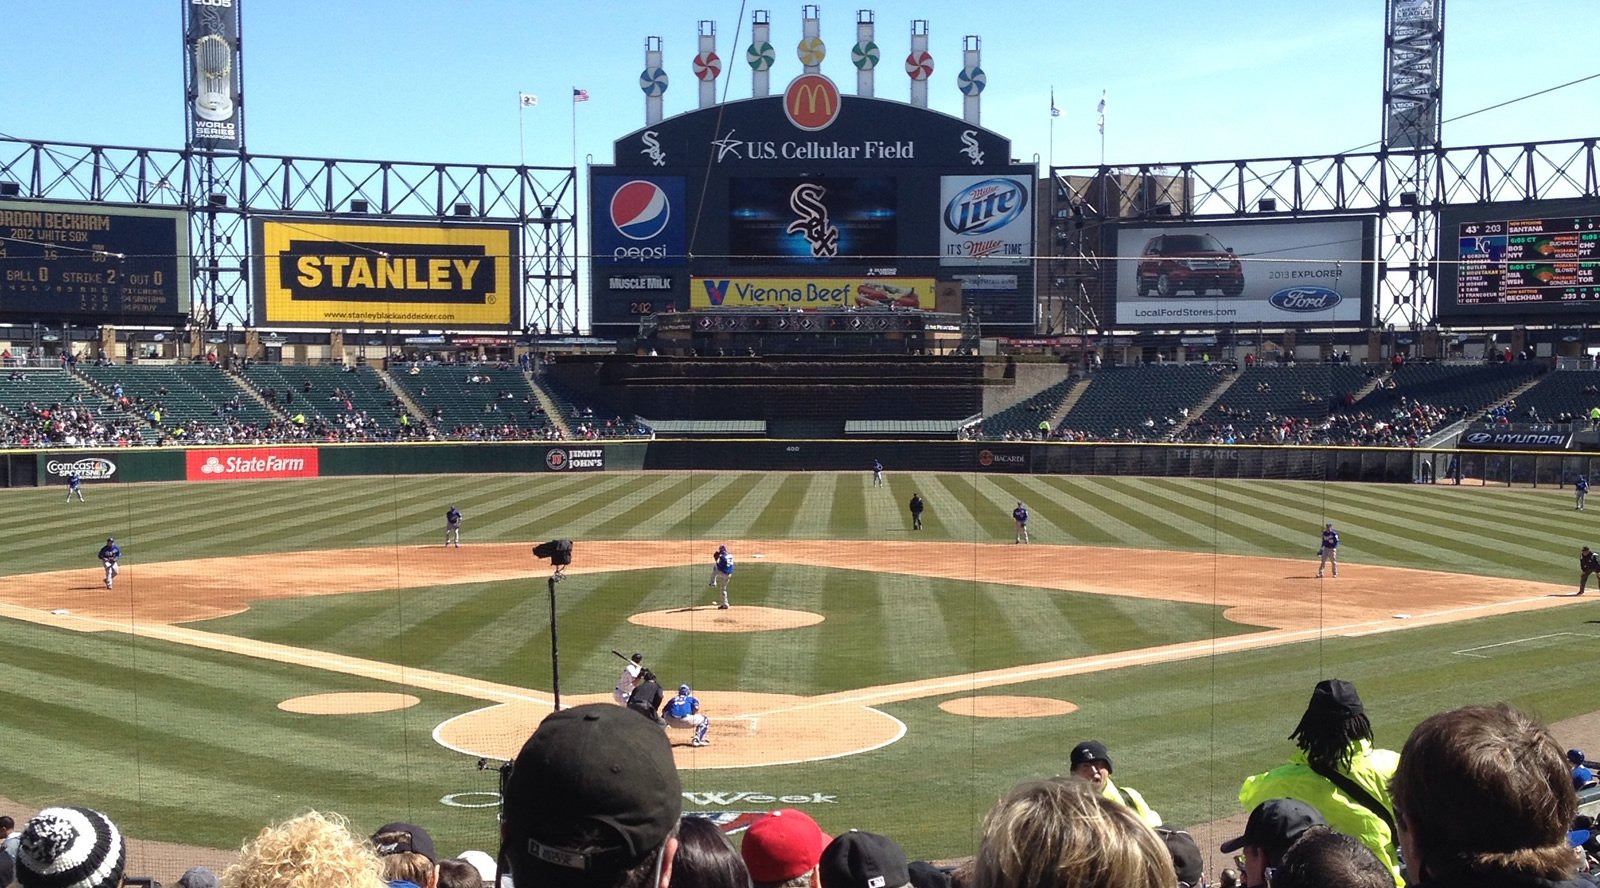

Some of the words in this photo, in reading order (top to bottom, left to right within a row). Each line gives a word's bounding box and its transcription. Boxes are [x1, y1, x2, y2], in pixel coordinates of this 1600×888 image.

[747, 142, 778, 160] U.S.
[782, 141, 860, 159] Cellular
[864, 141, 914, 159] Field
[969, 185, 1000, 200] Miller
[957, 188, 1017, 234] Lite
[45, 214, 110, 231] BECKHAM
[11, 229, 34, 239] 2012
[38, 231, 67, 242] WHITE
[68, 232, 88, 242] SOX
[614, 244, 667, 262] pepsi
[947, 244, 962, 256] IT'S
[962, 240, 1004, 256] Miller
[1004, 244, 1022, 255] TIME
[7, 270, 34, 282] BALL
[62, 272, 102, 283] STRIKE
[107, 269, 116, 284] 2
[130, 275, 149, 285] OUT
[154, 271, 162, 286] 0
[297, 256, 480, 290] STANLEY
[1269, 270, 1289, 279] 2013
[1291, 268, 1342, 279] EXPLORER
[609, 278, 646, 289] MUSCLE
[647, 278, 671, 289] MILK
[736, 283, 802, 302] Vienna
[806, 284, 850, 303] Beef
[1284, 290, 1327, 309] Ford
[324, 311, 456, 320] www.stanleyblackanddecker.com
[1135, 308, 1237, 318] LocalFordStores.com
[1494, 434, 1565, 445] HYUNDAI
[569, 450, 602, 459] JIMMY
[1176, 450, 1199, 458] THE
[568, 459, 603, 469] JOHN'S
[682, 792, 840, 805] Week
